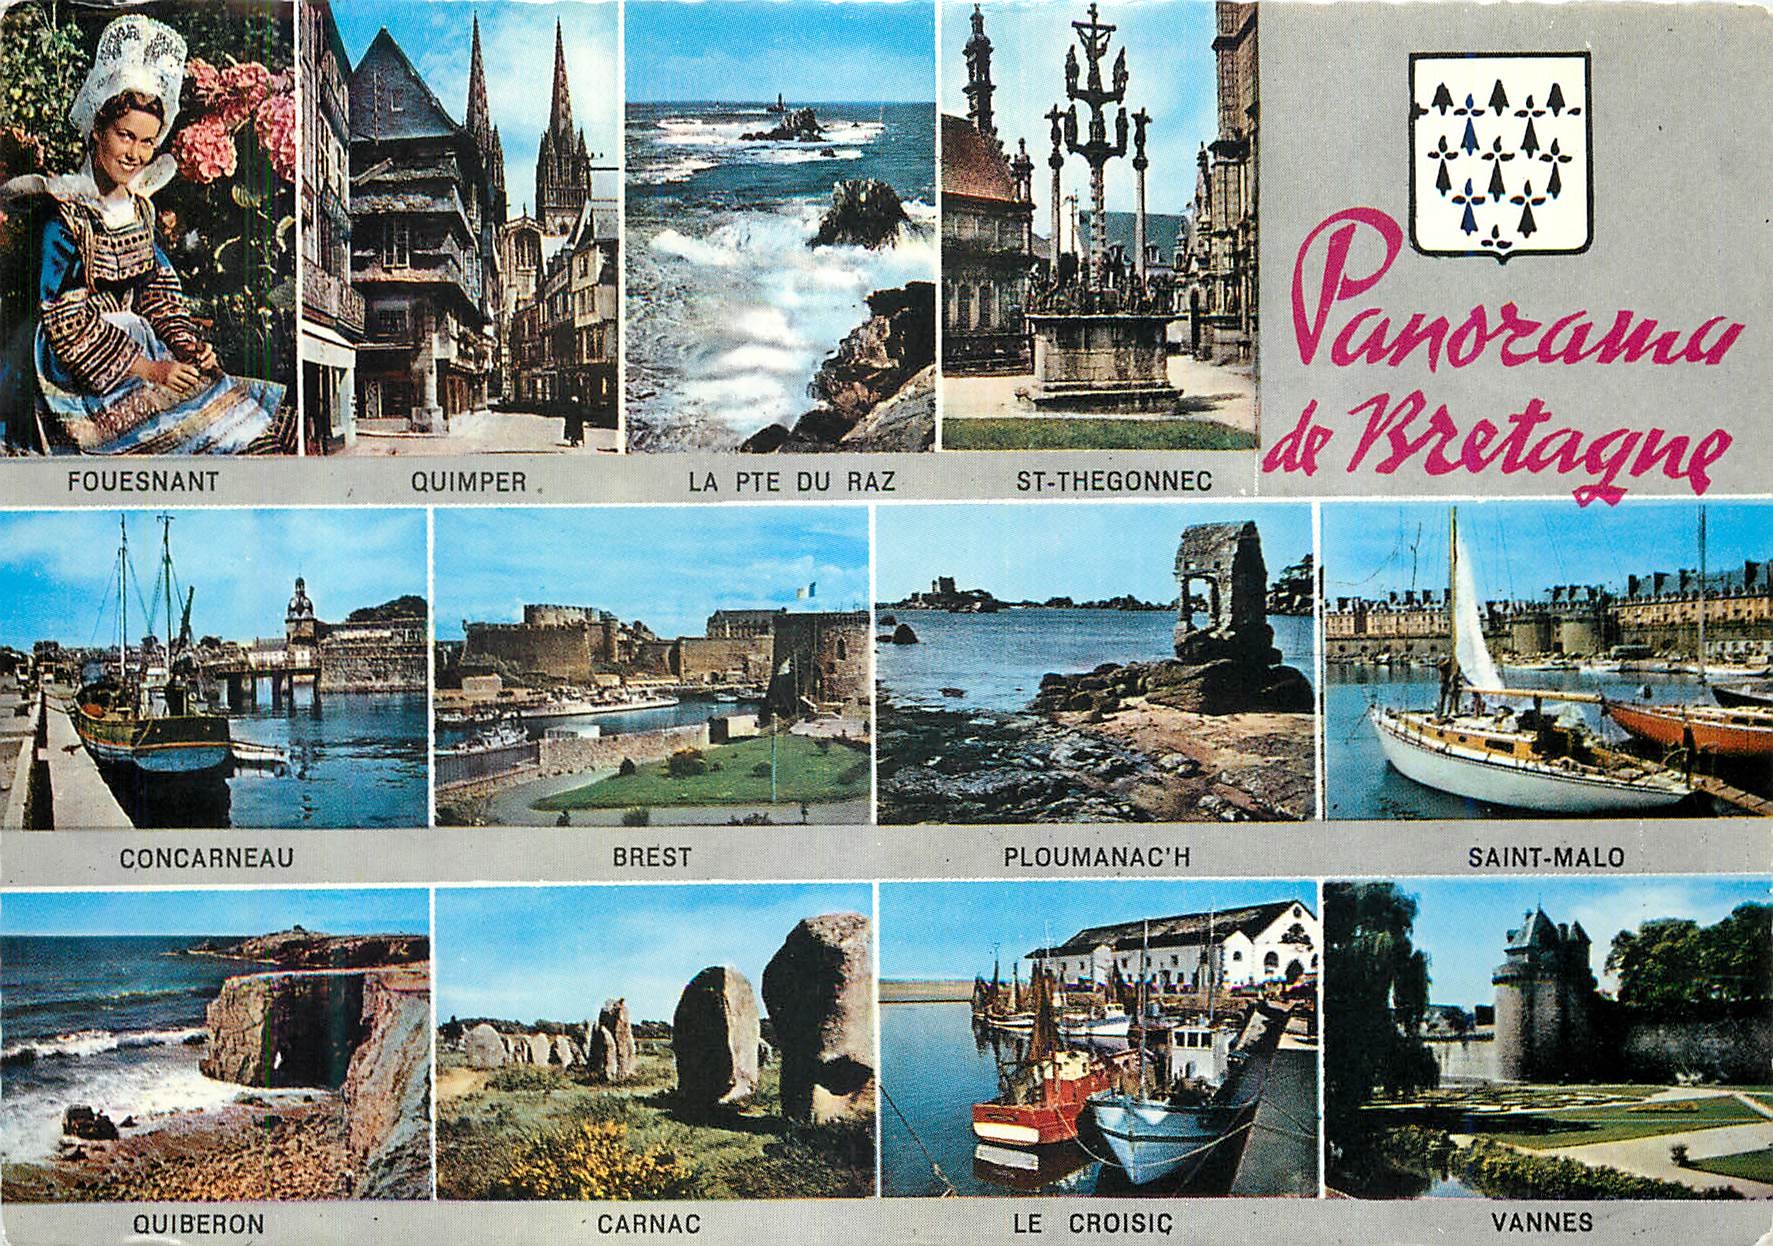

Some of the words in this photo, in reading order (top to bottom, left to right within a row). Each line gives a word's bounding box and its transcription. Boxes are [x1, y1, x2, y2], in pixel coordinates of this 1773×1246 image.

[1291, 207, 1745, 373] Panorama
[1262, 399, 1333, 477] de
[1347, 390, 1733, 507] Bretagne
[68, 470, 220, 492] FOUESNANT
[411, 471, 526, 493] QUIMPER
[689, 471, 718, 492] LA
[736, 471, 780, 492] PTE
[797, 471, 830, 492] DU
[848, 470, 896, 492] RAZ
[1017, 470, 1213, 492] ST-THEGONNEC
[120, 847, 294, 869] CONCARNEAU
[613, 846, 692, 868] BREST
[1004, 846, 1190, 868] PLOUMANAC'H
[1468, 846, 1625, 868] SAINT-MALO
[133, 1213, 264, 1235] QUIBERON
[597, 1213, 701, 1235] CARNAC
[1014, 1212, 1042, 1234] LE
[1490, 1211, 1593, 1233] VANNES
